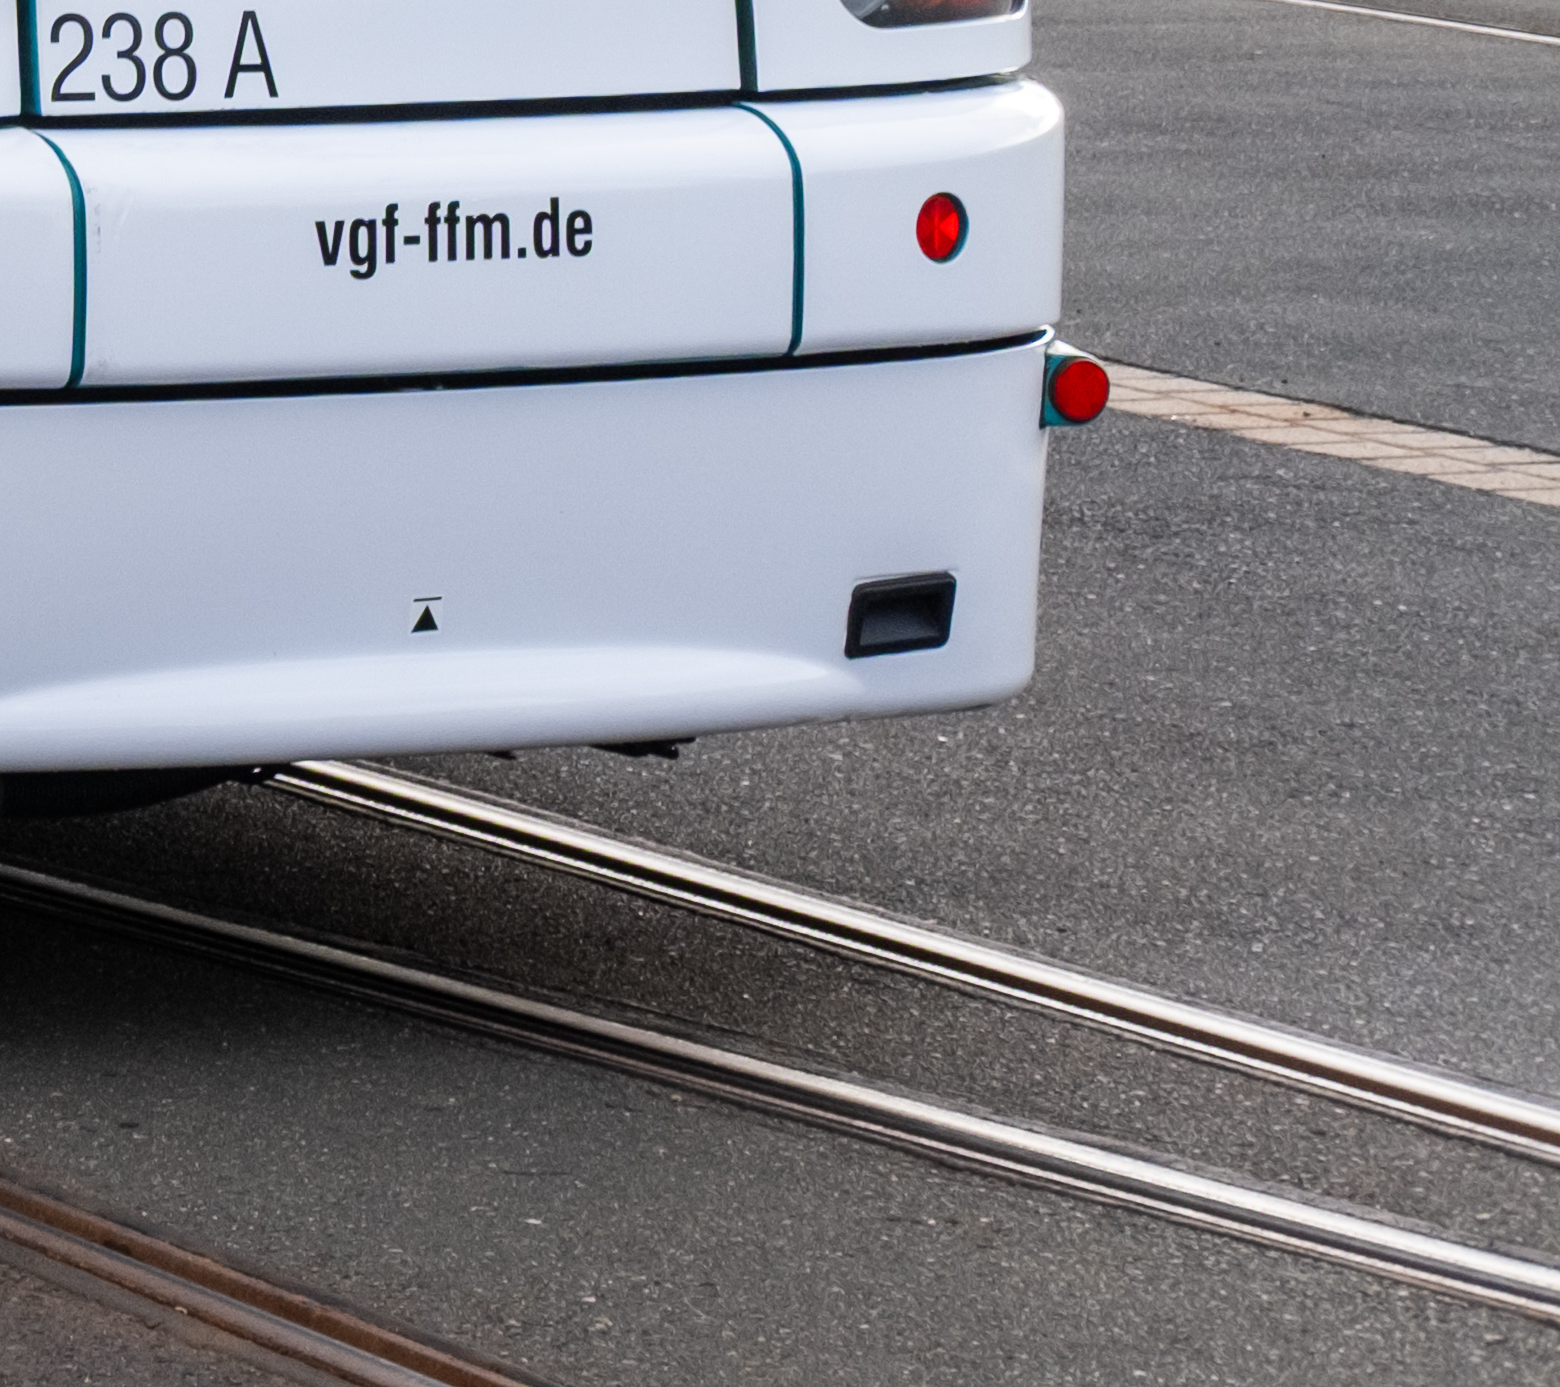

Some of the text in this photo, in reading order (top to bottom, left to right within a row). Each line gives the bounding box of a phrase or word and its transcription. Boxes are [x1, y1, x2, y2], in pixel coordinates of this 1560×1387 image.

[50, 10, 279, 102] 238 A
[315, 196, 594, 280] vgf-ffm.de
